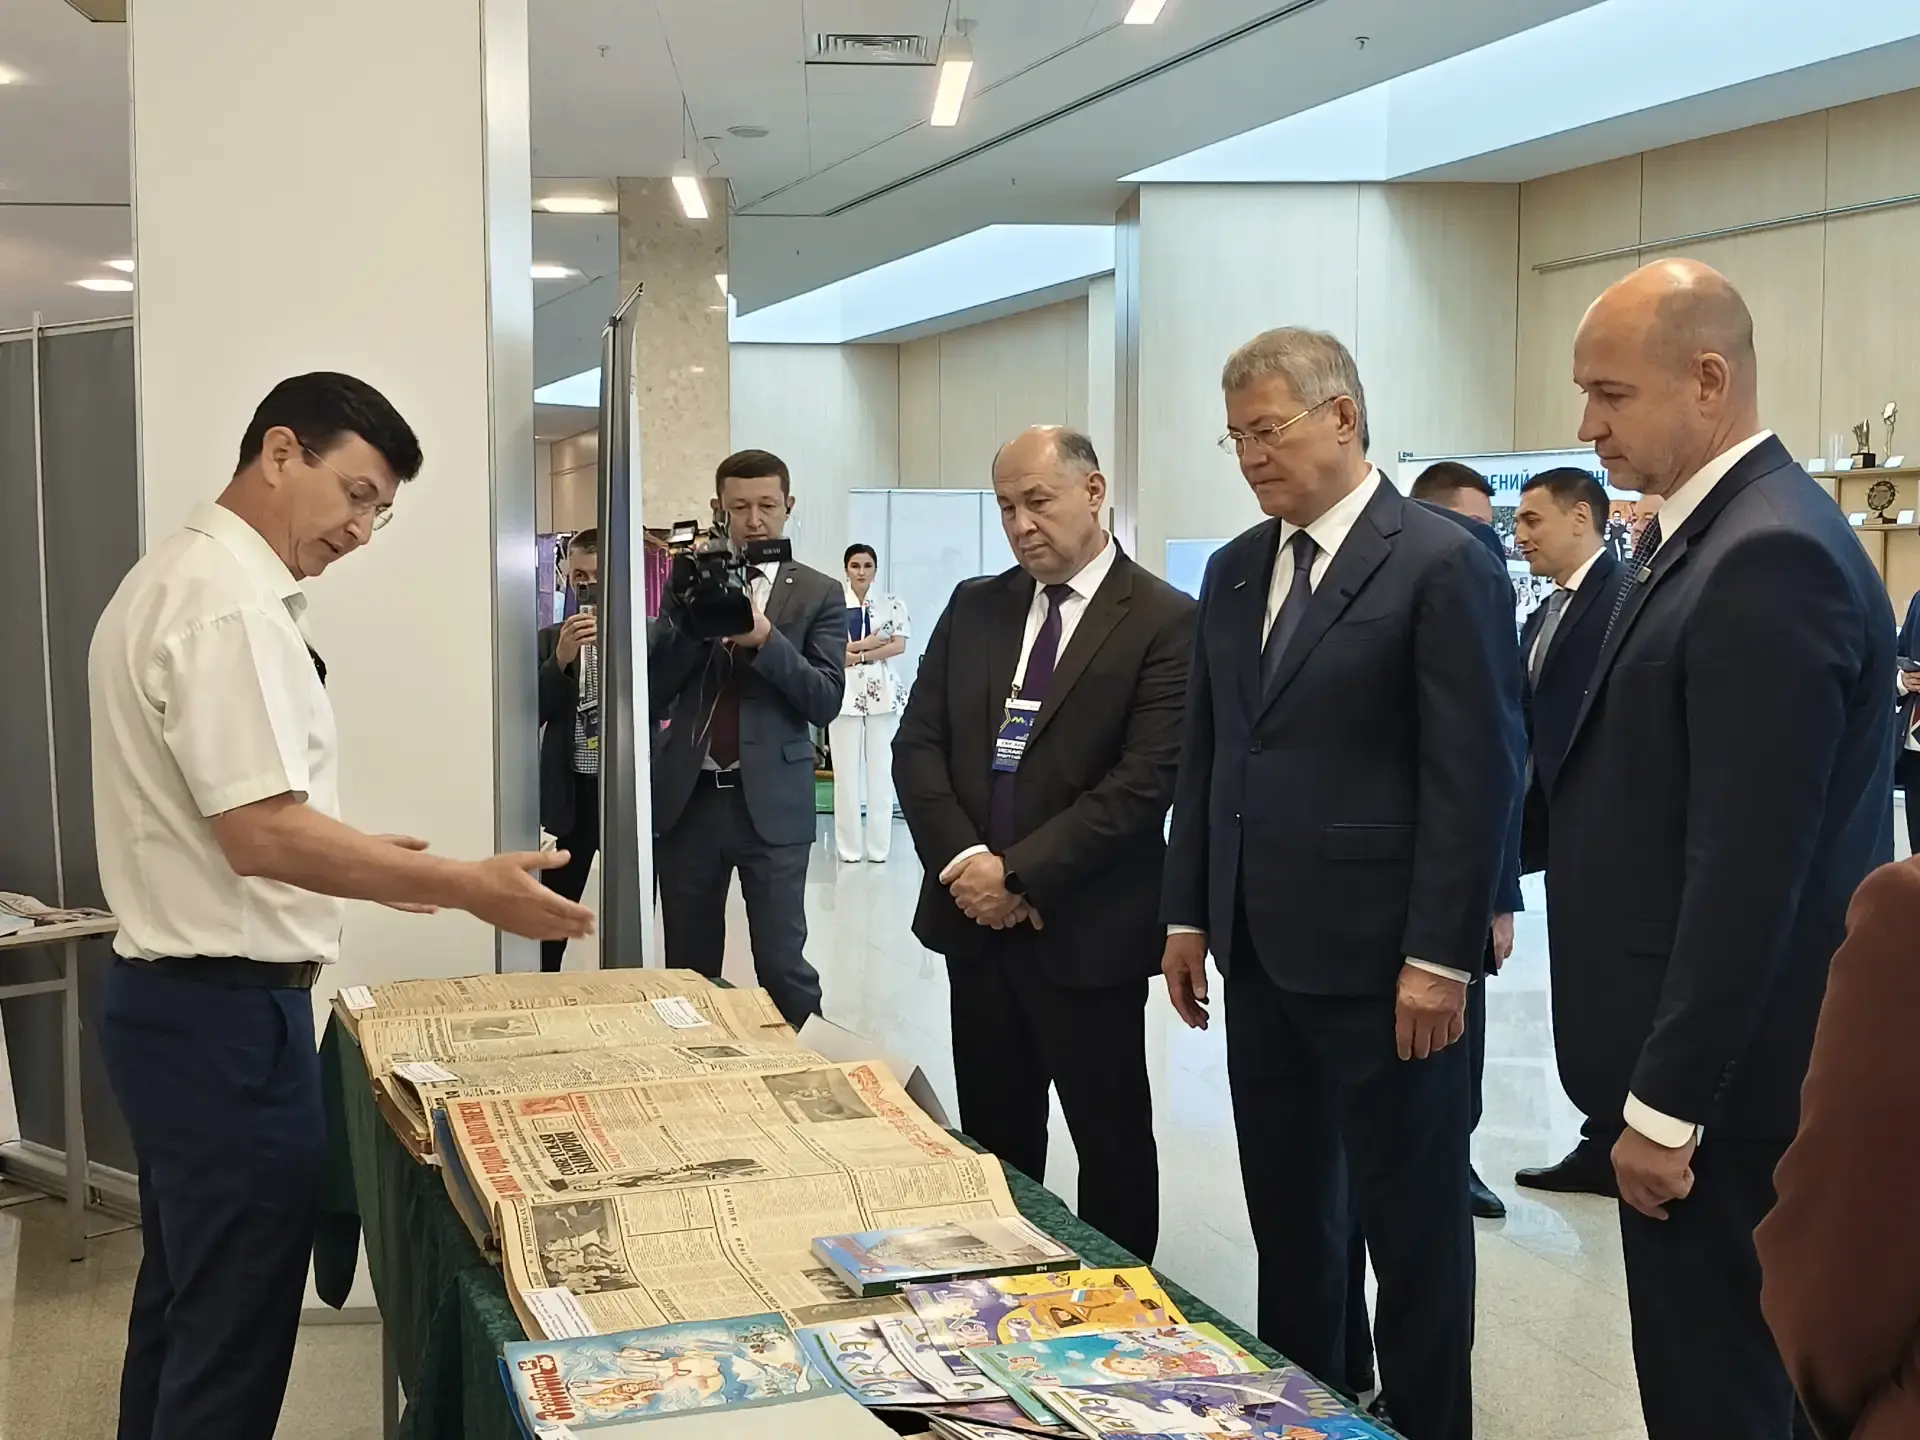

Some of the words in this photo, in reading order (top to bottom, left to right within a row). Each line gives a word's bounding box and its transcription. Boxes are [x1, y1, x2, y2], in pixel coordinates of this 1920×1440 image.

[1487, 468, 1529, 490] ЕНИЙ
[474, 1146, 510, 1174] РОДИНЫ
[538, 1134, 577, 1176] СОВЕТСКАЯ
[554, 1131, 600, 1175] БАШКИРИЯ
